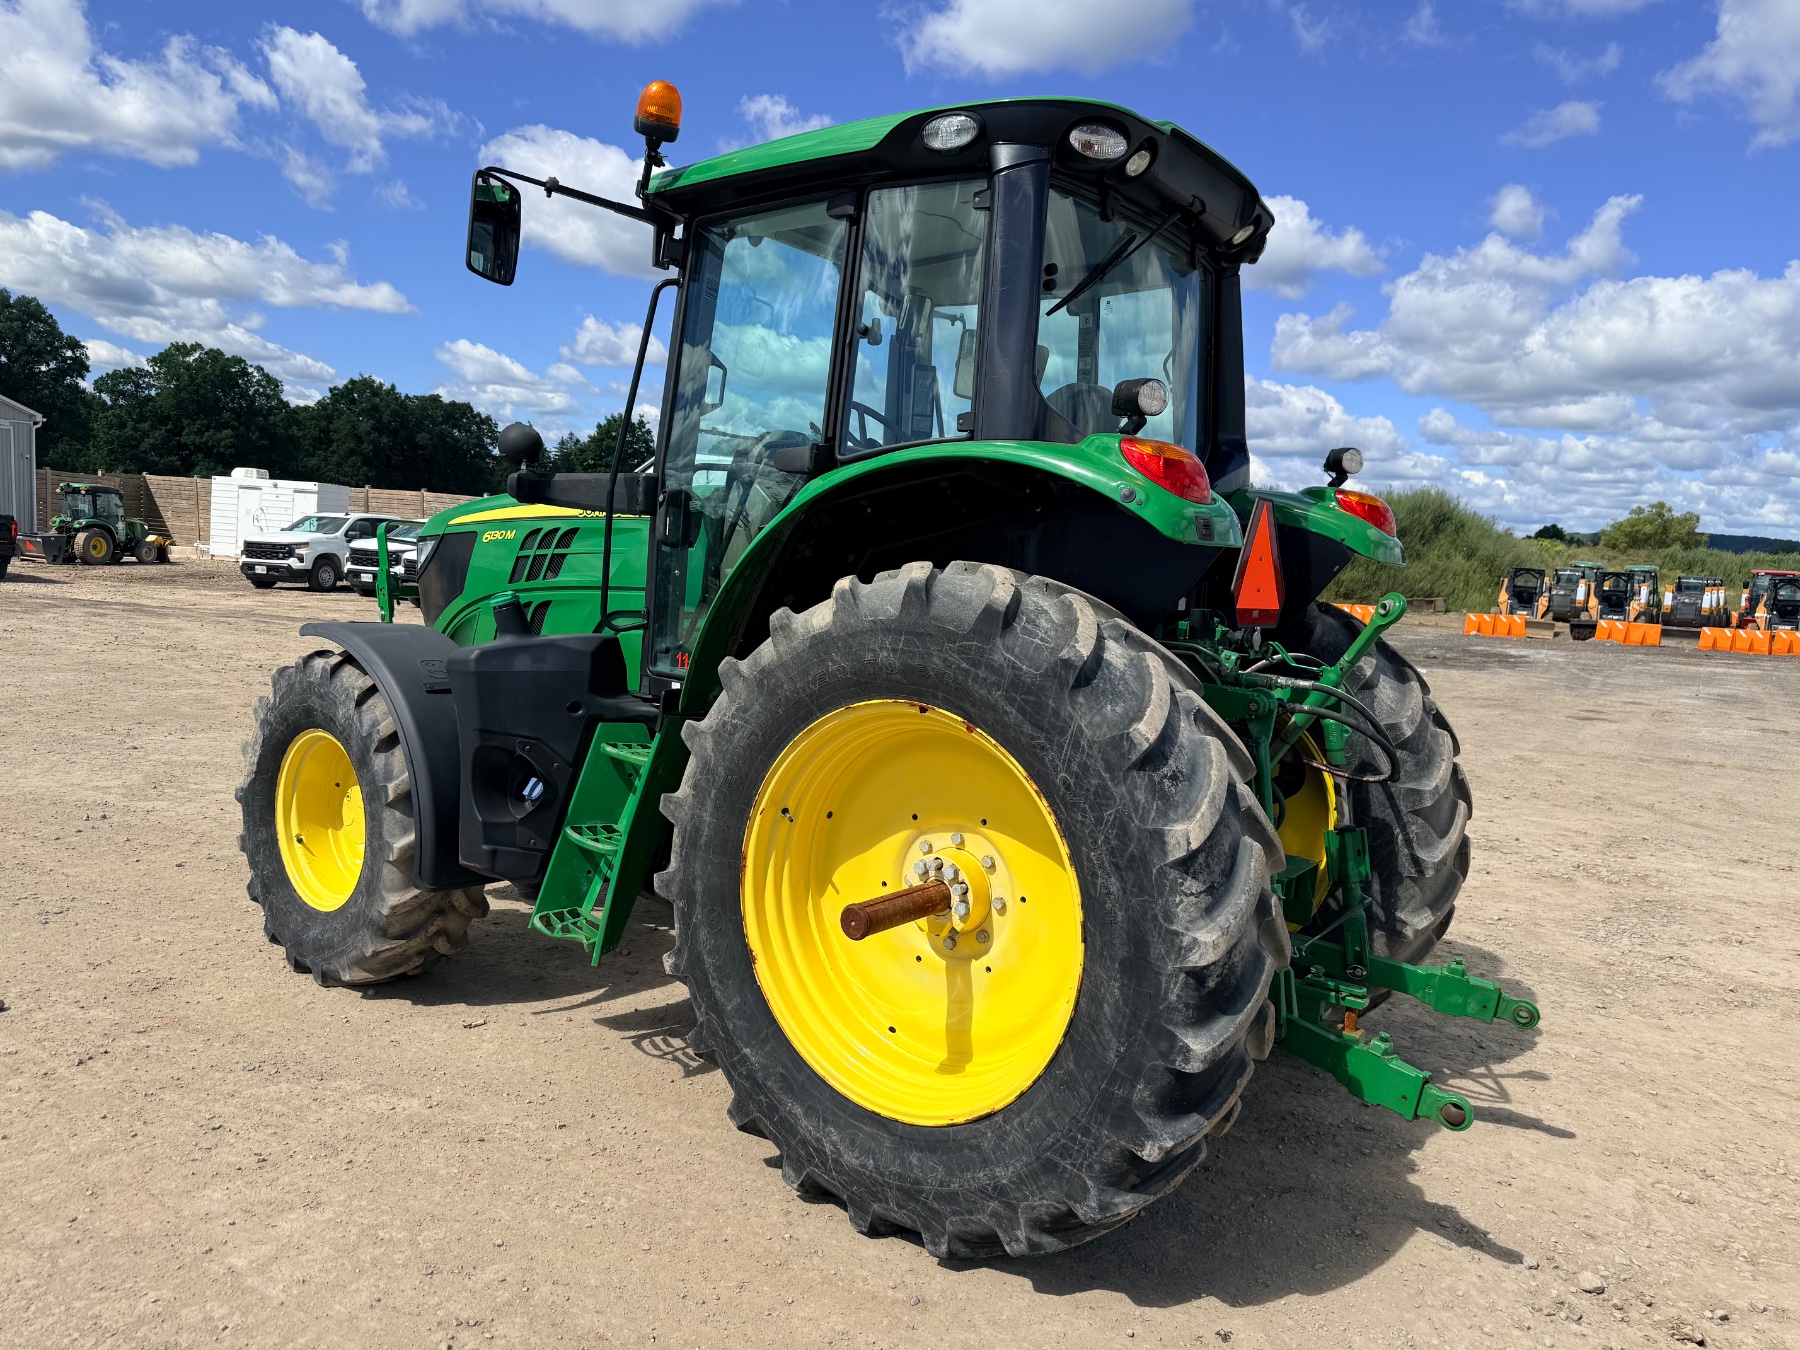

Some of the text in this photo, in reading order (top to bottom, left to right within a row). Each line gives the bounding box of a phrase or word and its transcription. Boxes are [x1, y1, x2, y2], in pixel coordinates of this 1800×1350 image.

[482, 529, 517, 543] 6130M
[676, 651, 689, 670] 11
[711, 657, 965, 818] PERFORMER 70 EXTRA
